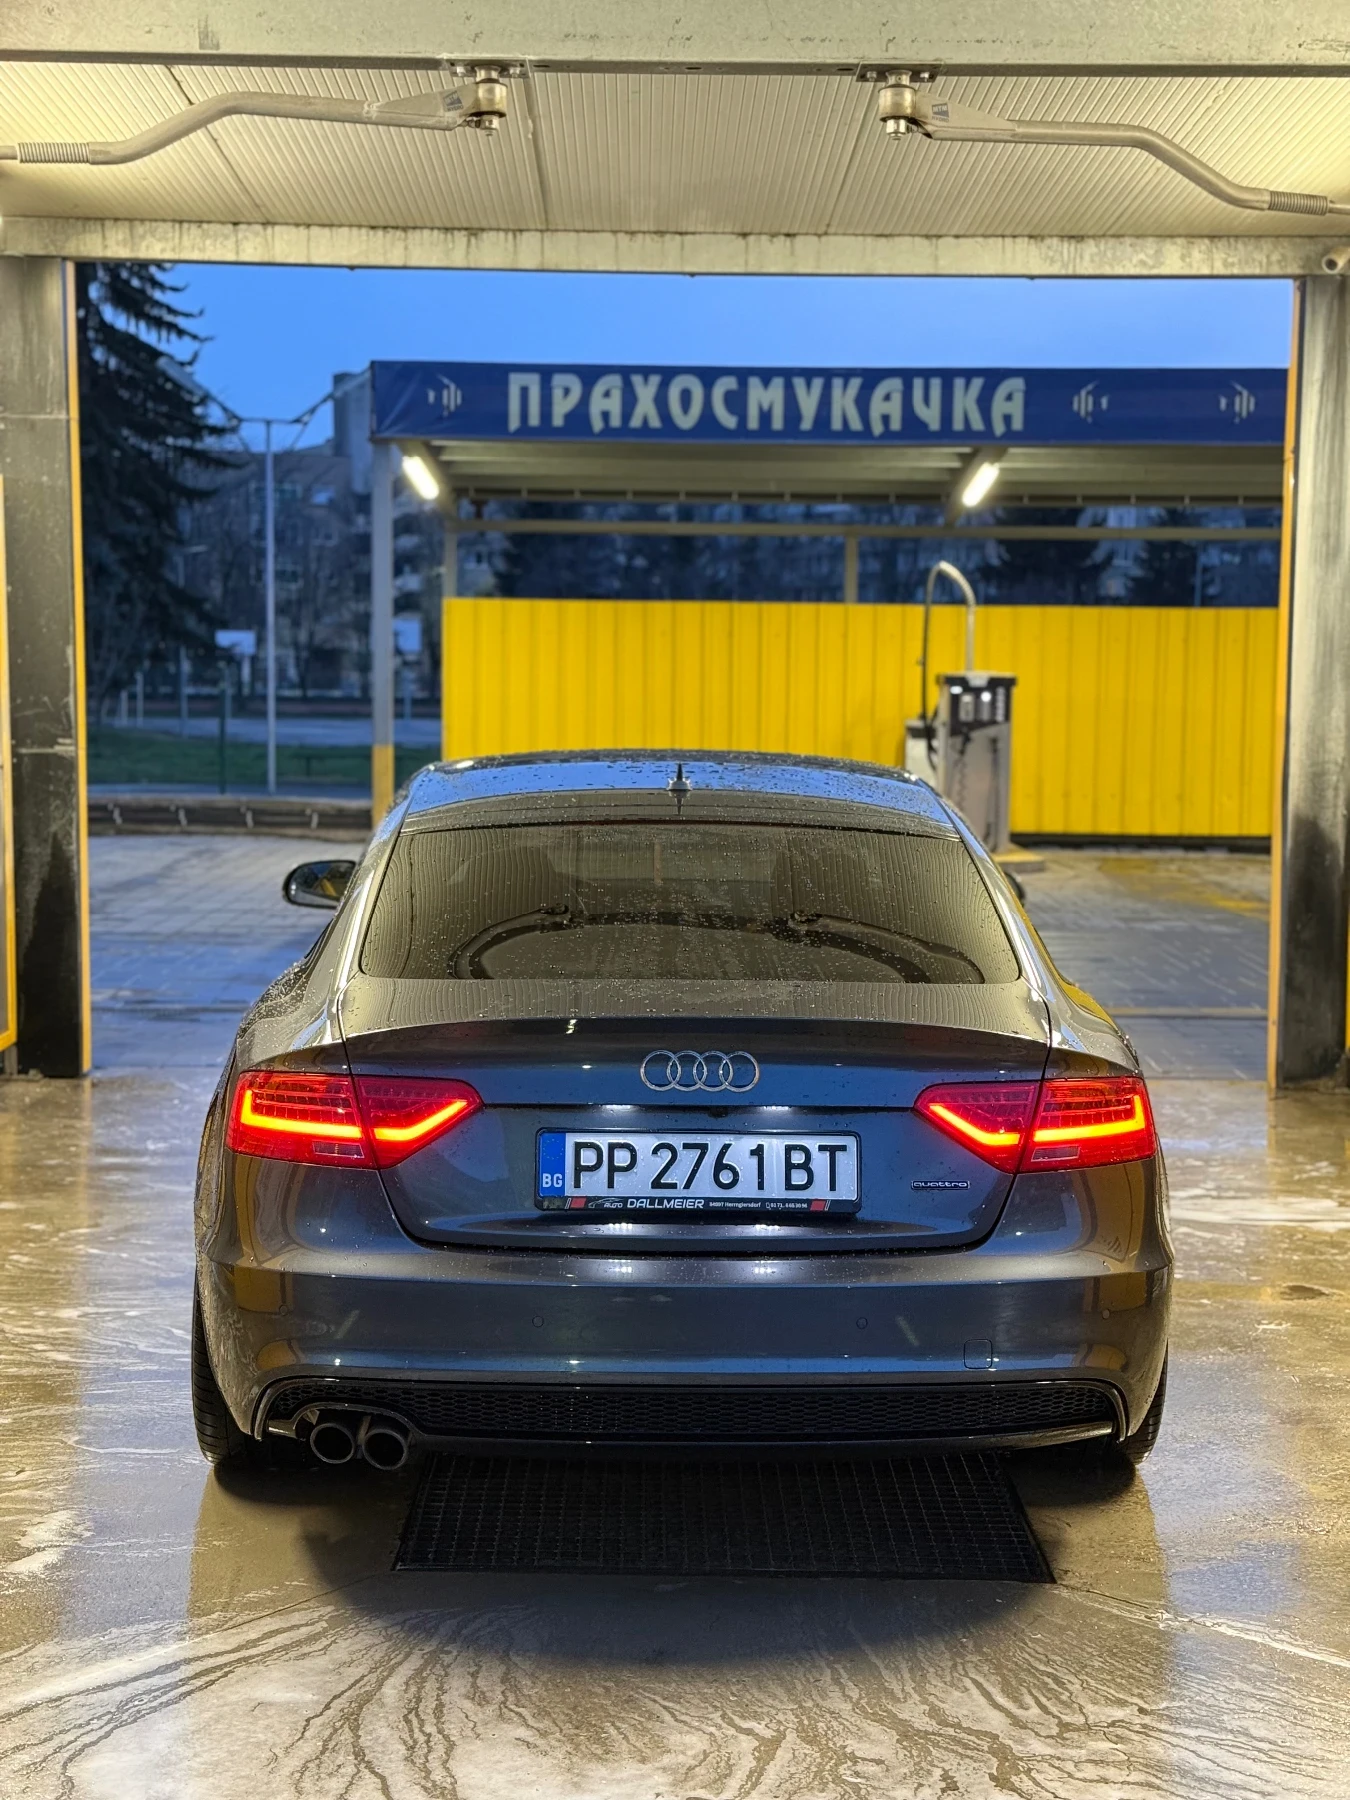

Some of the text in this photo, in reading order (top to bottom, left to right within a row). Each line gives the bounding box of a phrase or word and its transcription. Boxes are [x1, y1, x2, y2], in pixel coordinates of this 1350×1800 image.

[932, 105, 948, 113] MTM
[508, 372, 1026, 438] ПРАХОСМУКАЧКА
[573, 1141, 848, 1192] PP 2761 BT
[542, 1173, 563, 1188] BG
[627, 1199, 705, 1209] DALLMEIER
